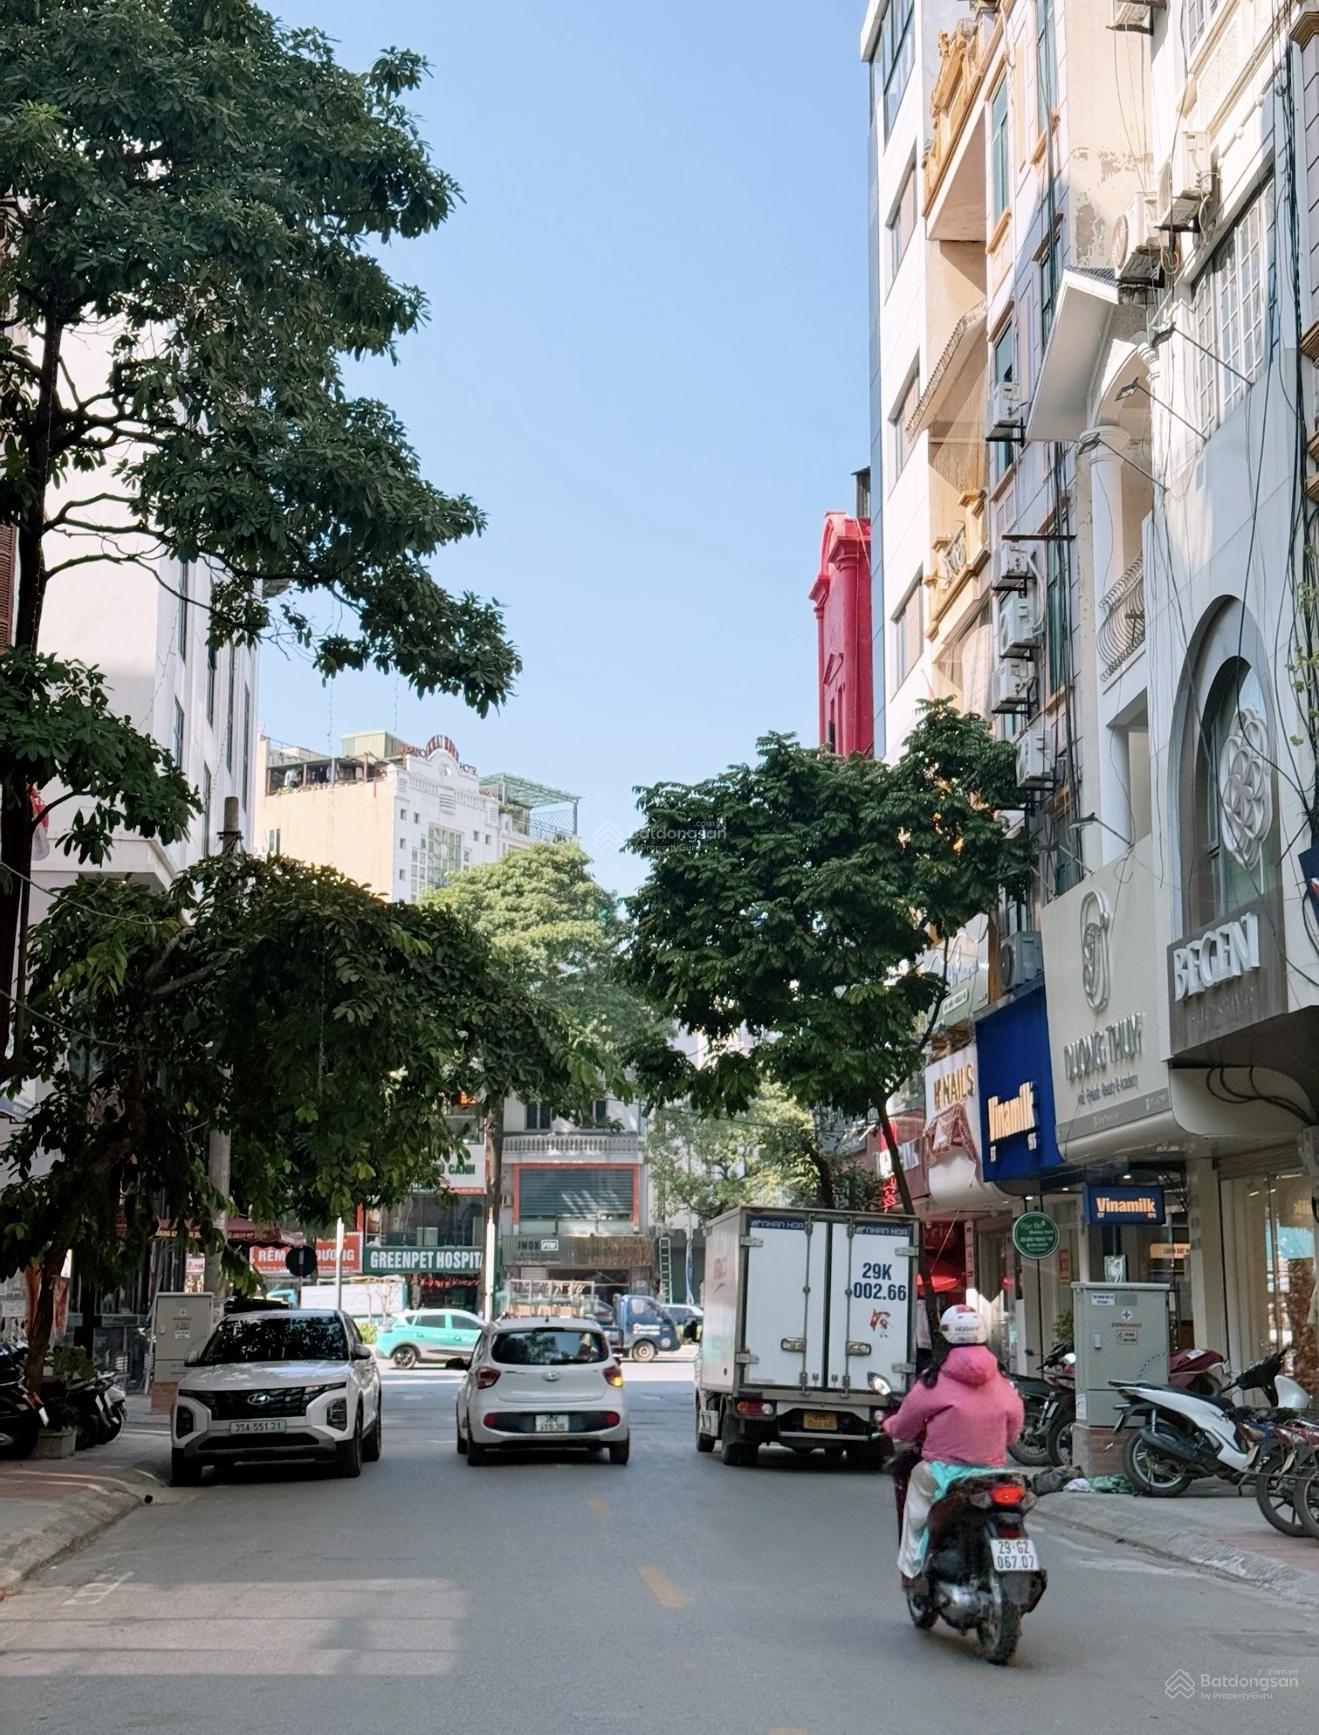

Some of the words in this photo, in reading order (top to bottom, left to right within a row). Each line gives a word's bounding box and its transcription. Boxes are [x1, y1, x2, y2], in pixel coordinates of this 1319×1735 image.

[1173, 911, 1261, 1002] BEGEN
[1096, 1197, 1156, 1214] Vinamilk
[370, 1251, 435, 1269] GREENPET
[862, 1262, 893, 1281] 29K
[853, 1282, 907, 1301] 002.66
[996, 1554, 1035, 1569] 067.07
